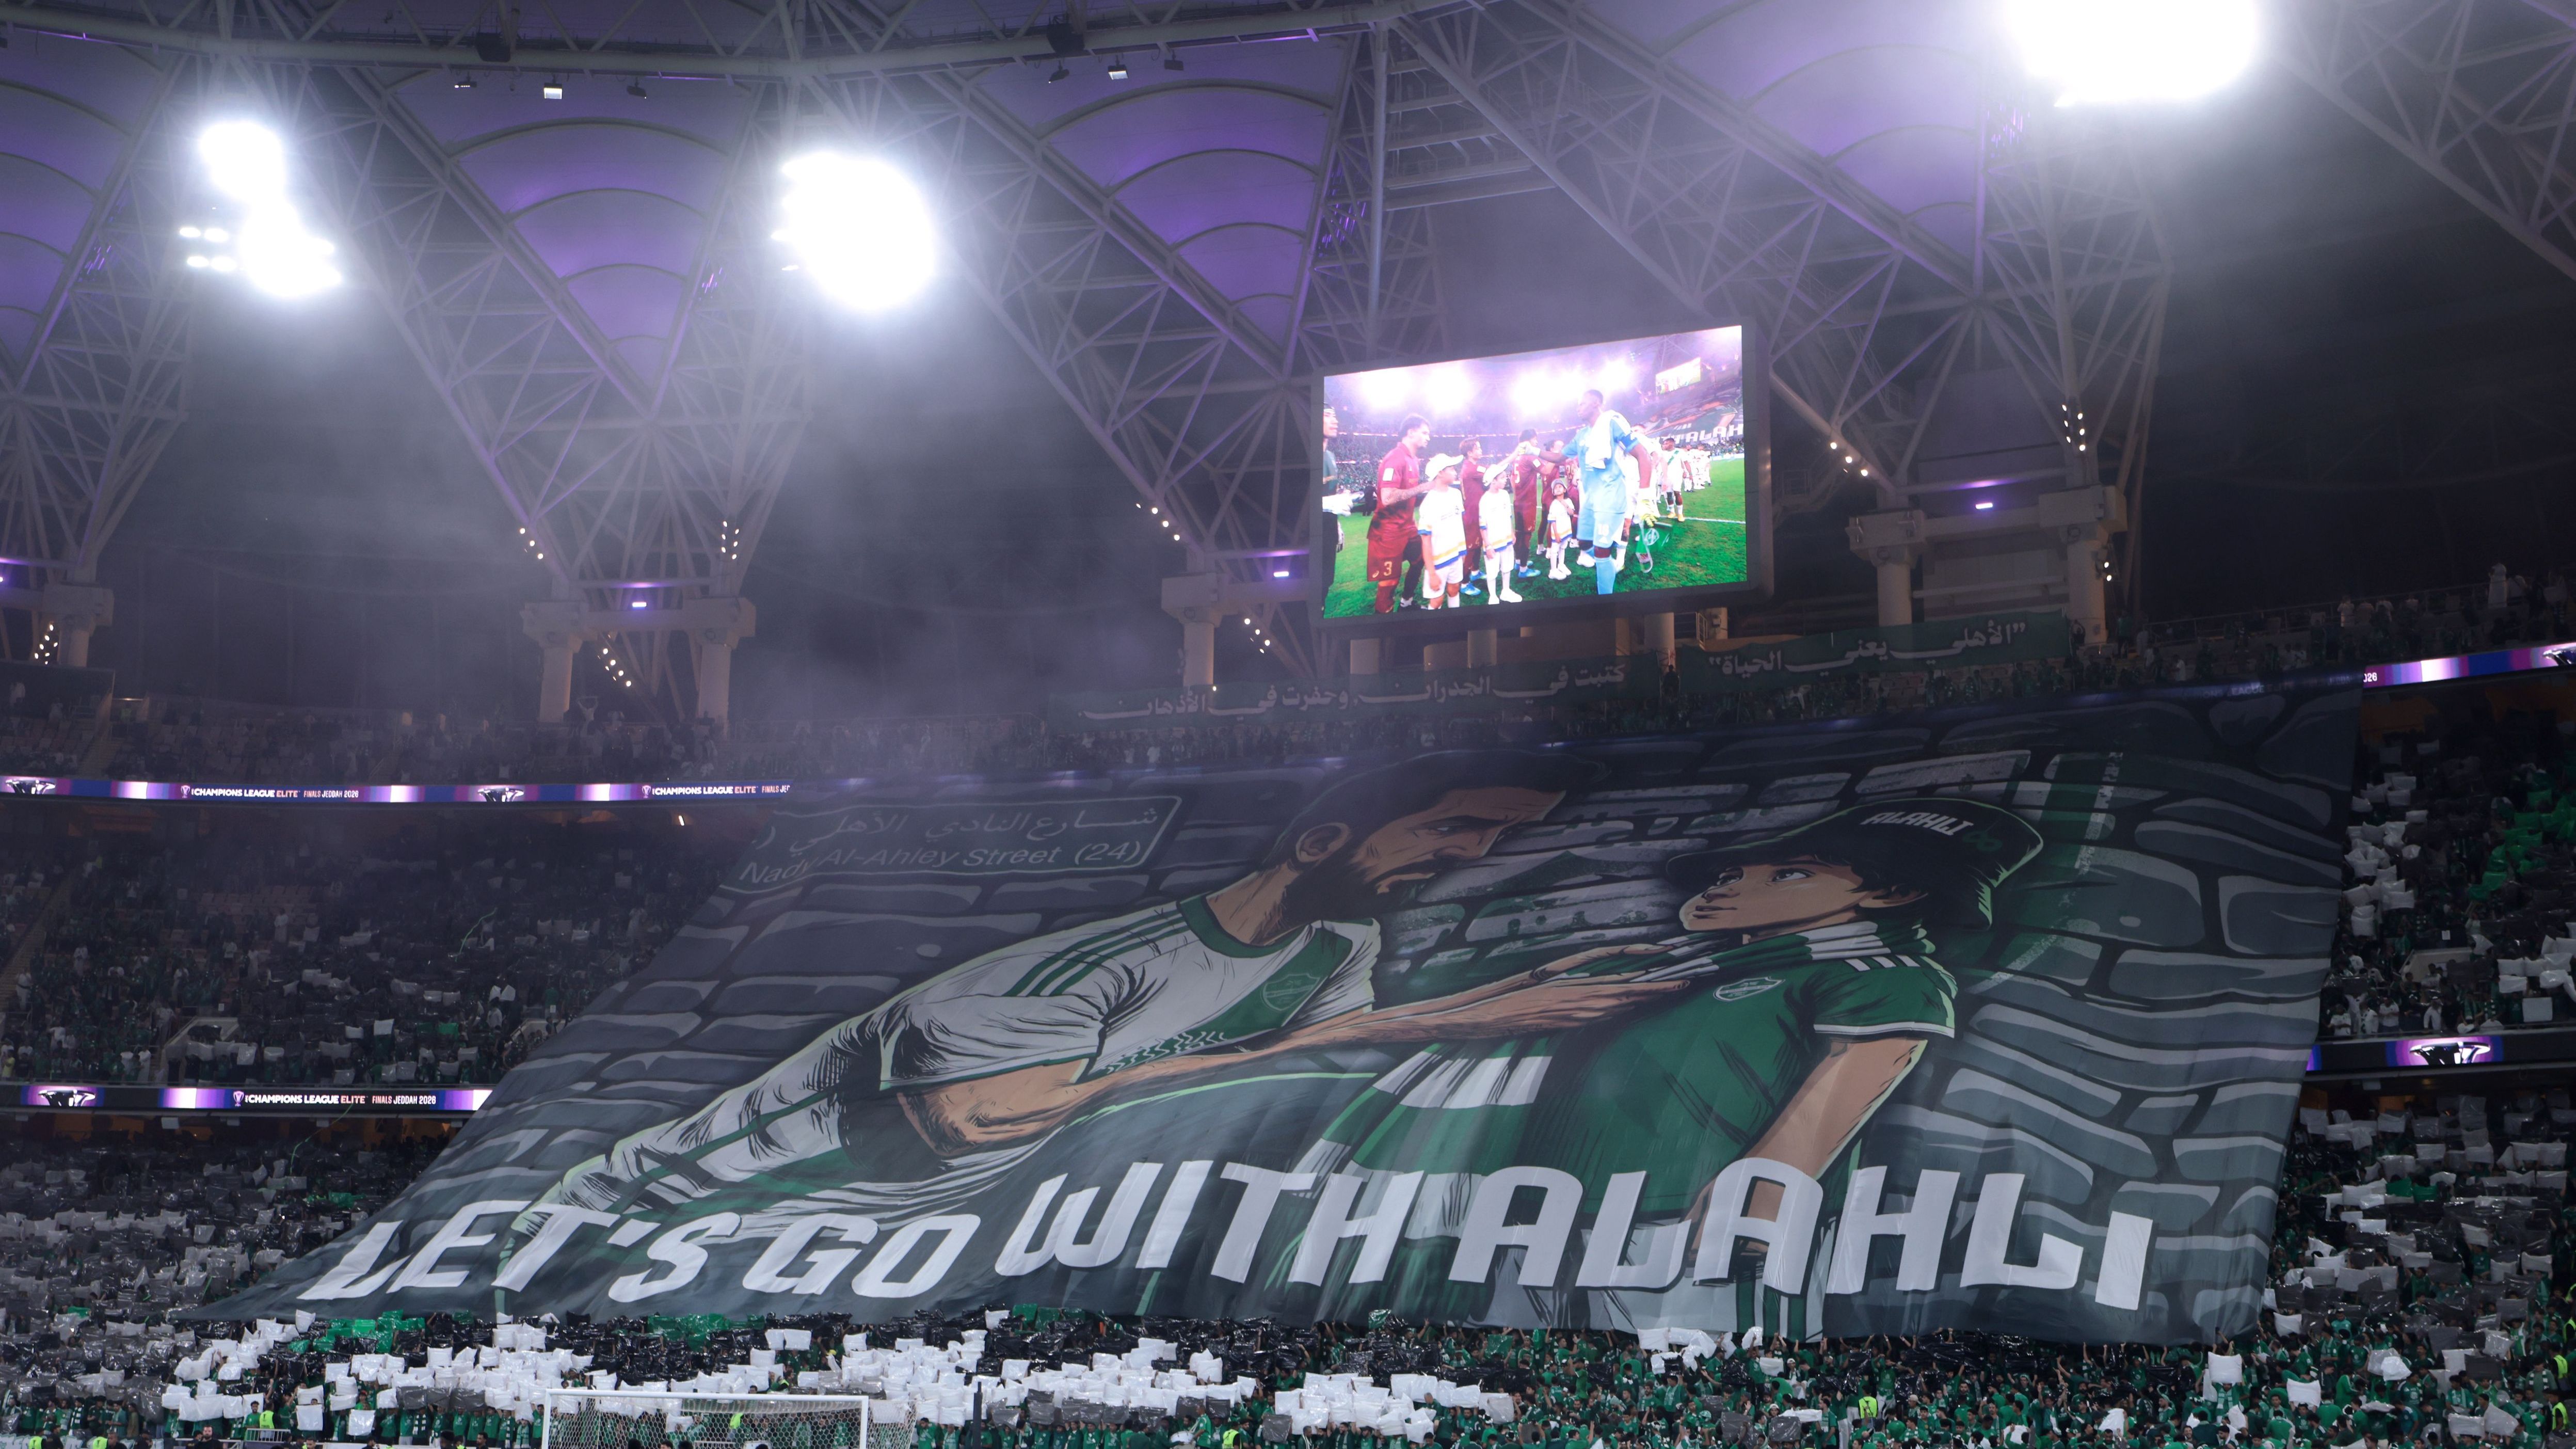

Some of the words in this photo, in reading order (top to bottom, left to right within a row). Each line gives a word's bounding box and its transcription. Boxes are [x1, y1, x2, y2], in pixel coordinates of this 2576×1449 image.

[1383, 561, 1393, 576] 3
[1784, 638, 1888, 677] يعني
[1492, 665, 1569, 704] في
[1574, 664, 1625, 688] كتبت
[1208, 684, 1277, 721] في
[1282, 686, 1349, 711] وحفرت
[194, 788, 243, 797] CHAMPIONS
[654, 787, 702, 795] CHAMPIONS
[703, 786, 733, 794] LEAGUE
[925, 812, 1032, 843] النادي
[1026, 807, 1158, 841] شارع
[1859, 811, 1974, 836] ALAHLI
[739, 857, 819, 884] Nady
[817, 848, 960, 868] Al-Ahley
[963, 846, 1062, 867] Street
[1075, 841, 1141, 866] (24)
[248, 1095, 302, 1104] CHAMPIONS
[303, 1095, 339, 1104] LEAGUE
[340, 1095, 365, 1104] ELITE
[372, 1096, 392, 1104] FINALS
[393, 1095, 418, 1105] JEDDAH
[419, 1095, 437, 1105] 2026
[742, 1213, 983, 1300] GO
